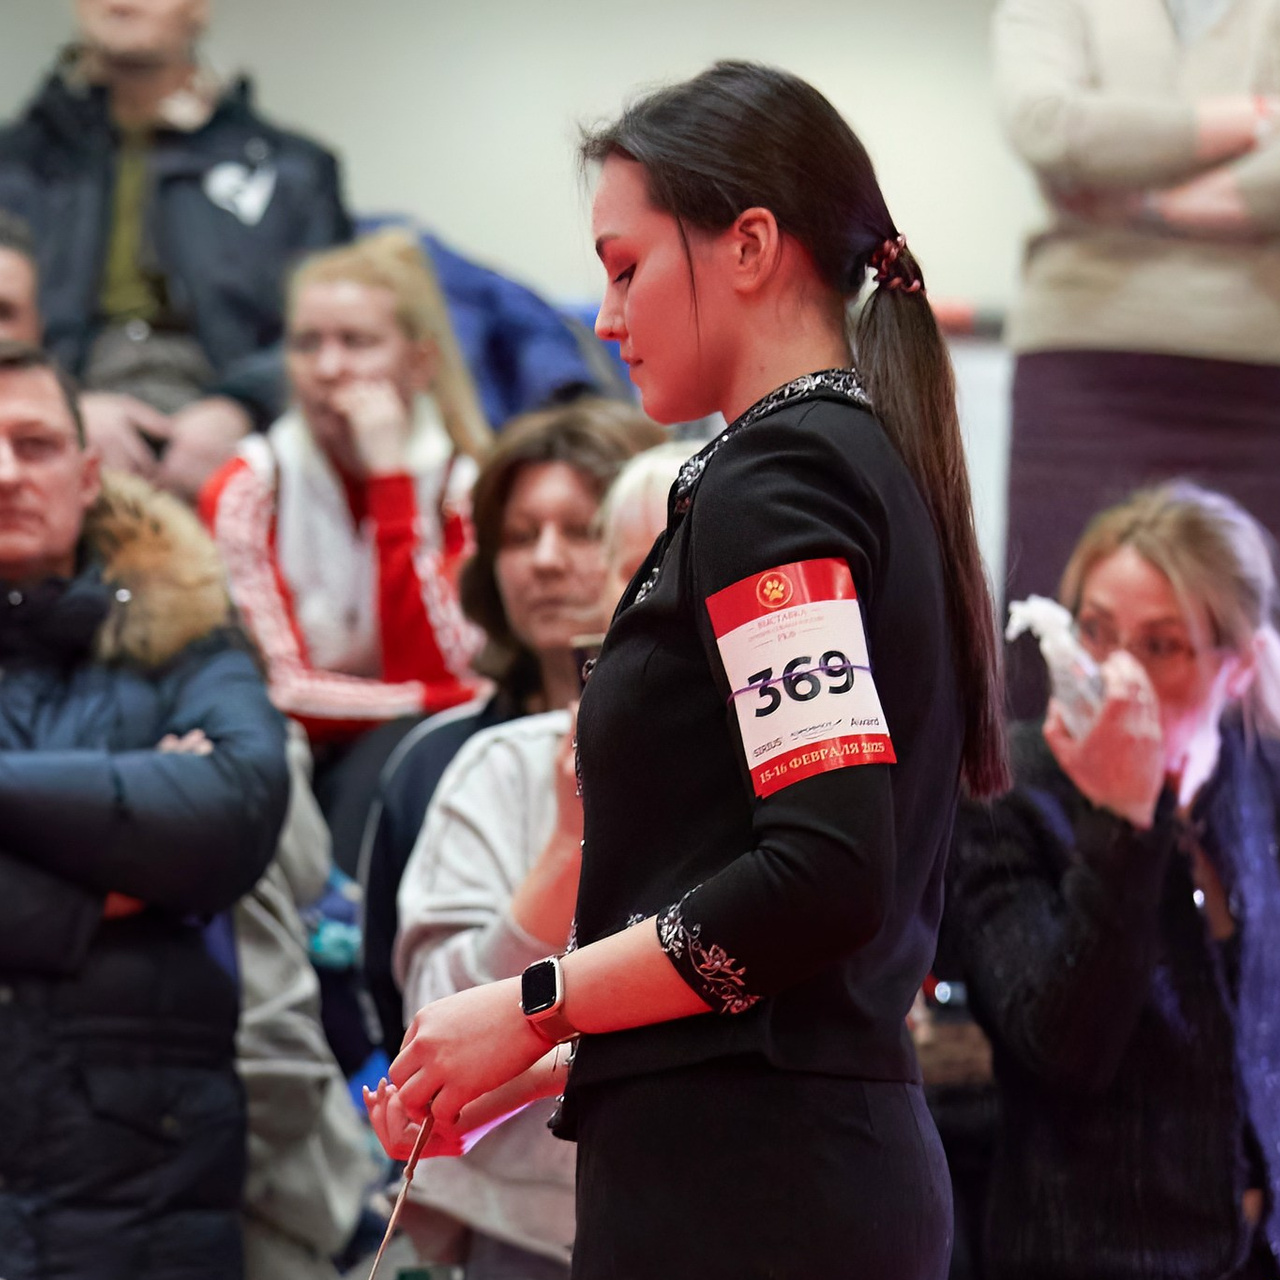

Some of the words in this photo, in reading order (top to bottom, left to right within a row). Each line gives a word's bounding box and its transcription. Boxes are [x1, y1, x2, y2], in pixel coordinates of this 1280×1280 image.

[748, 650, 855, 718] 369
[760, 762, 788, 784] 15-16
[788, 742, 859, 770] ФЕВРАЛЯ
